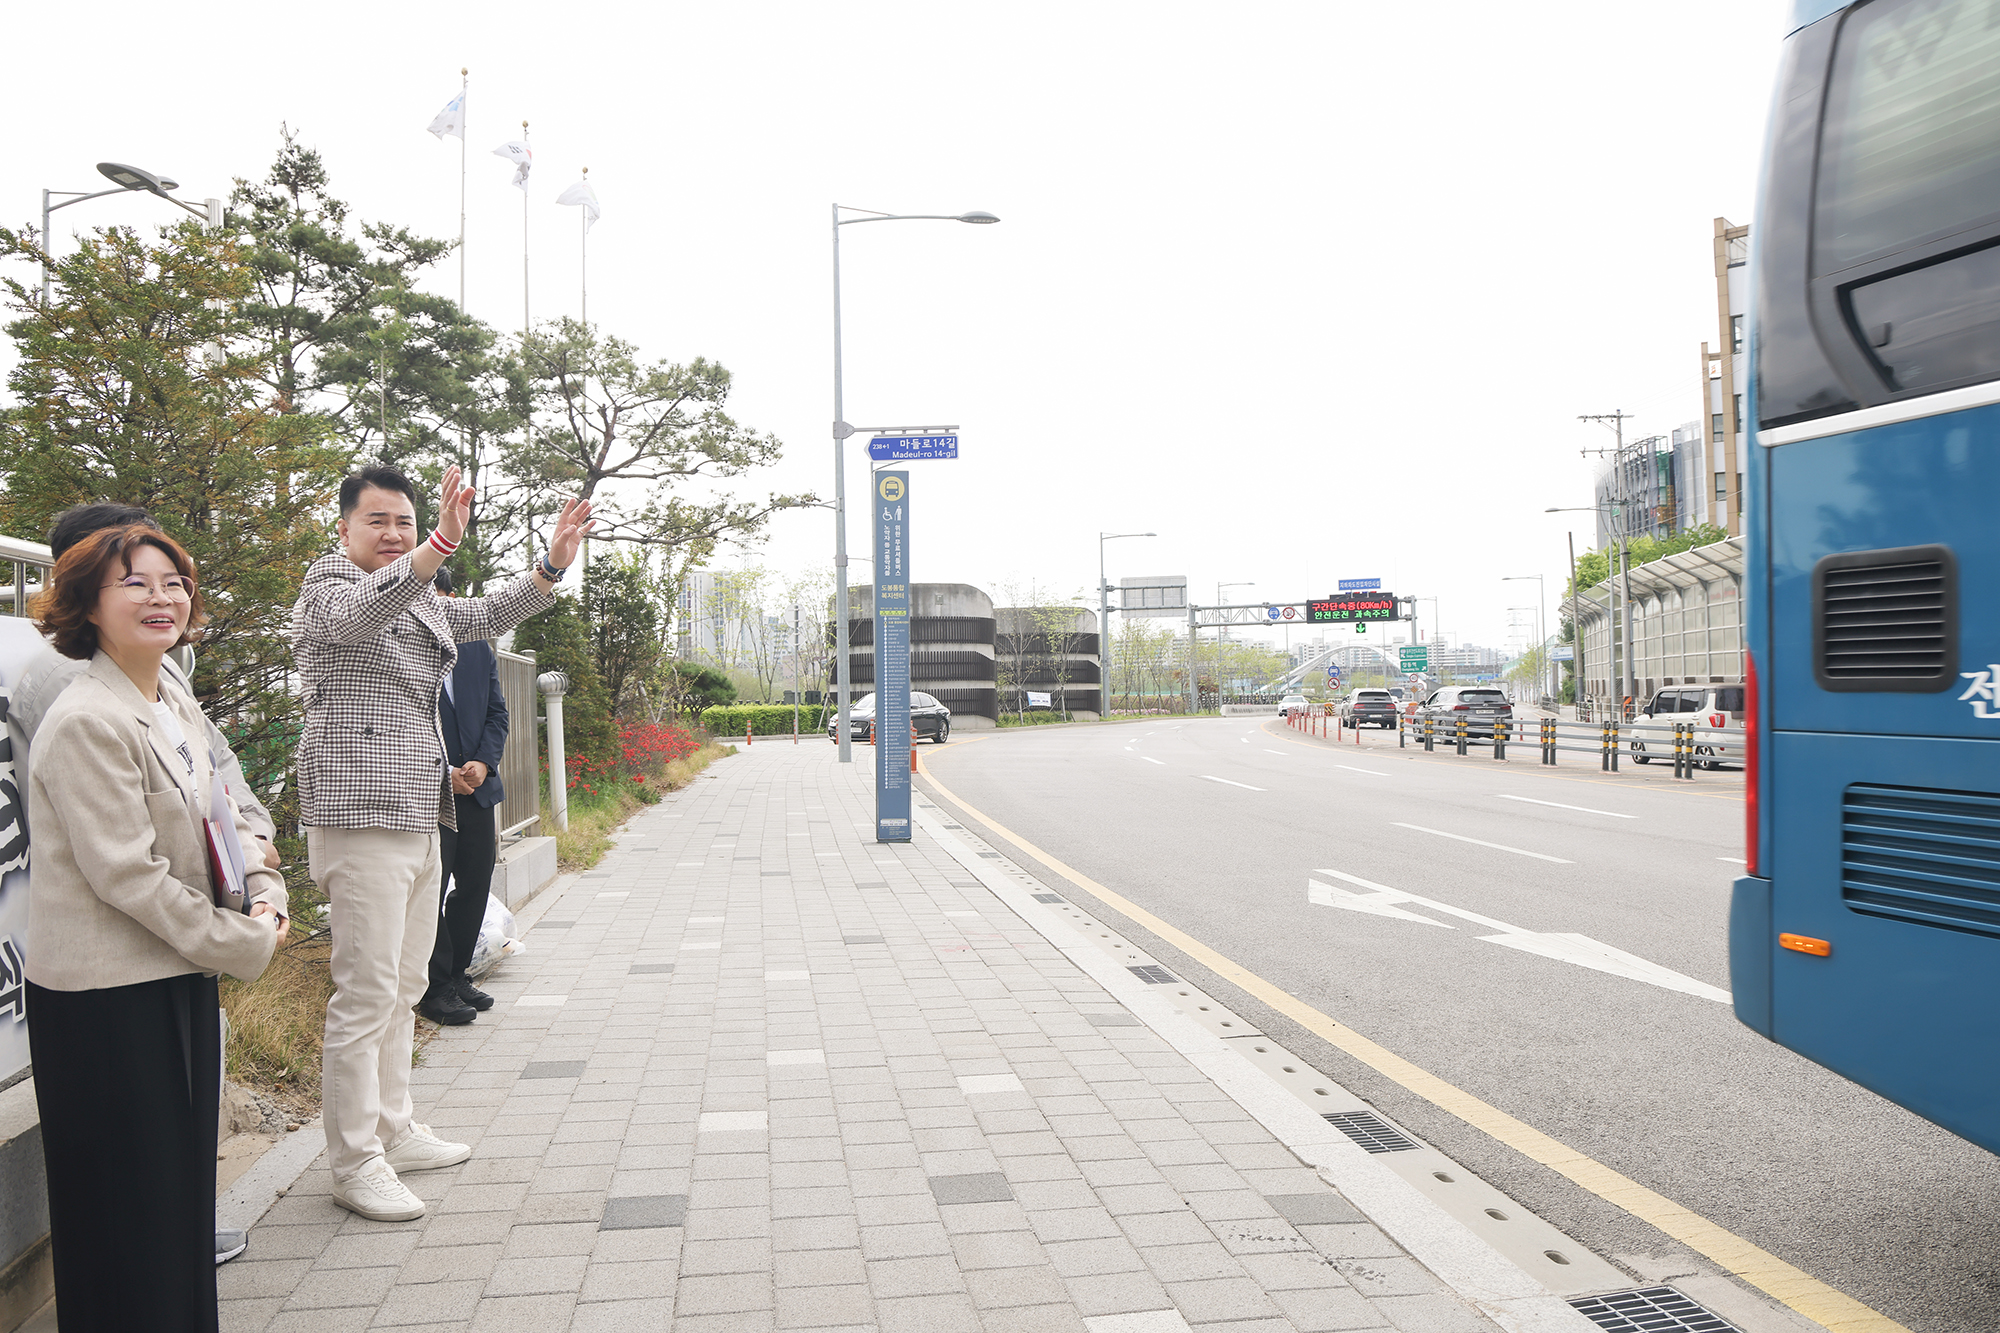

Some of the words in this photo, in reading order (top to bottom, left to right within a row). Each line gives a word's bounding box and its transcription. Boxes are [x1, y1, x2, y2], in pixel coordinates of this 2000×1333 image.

[900, 437, 956, 450] 마들로14길
[892, 451, 932, 459] Madeul-ro
[934, 450, 956, 459] 14-gil
[881, 584, 905, 592] 도봉통합
[881, 592, 905, 600] 복지센터
[1312, 600, 1393, 612] 구간단속중(80Km/h)
[1314, 611, 1350, 620] 안전운전
[1354, 609, 1390, 619] 과속주의
[1957, 664, 2000, 719] 전
